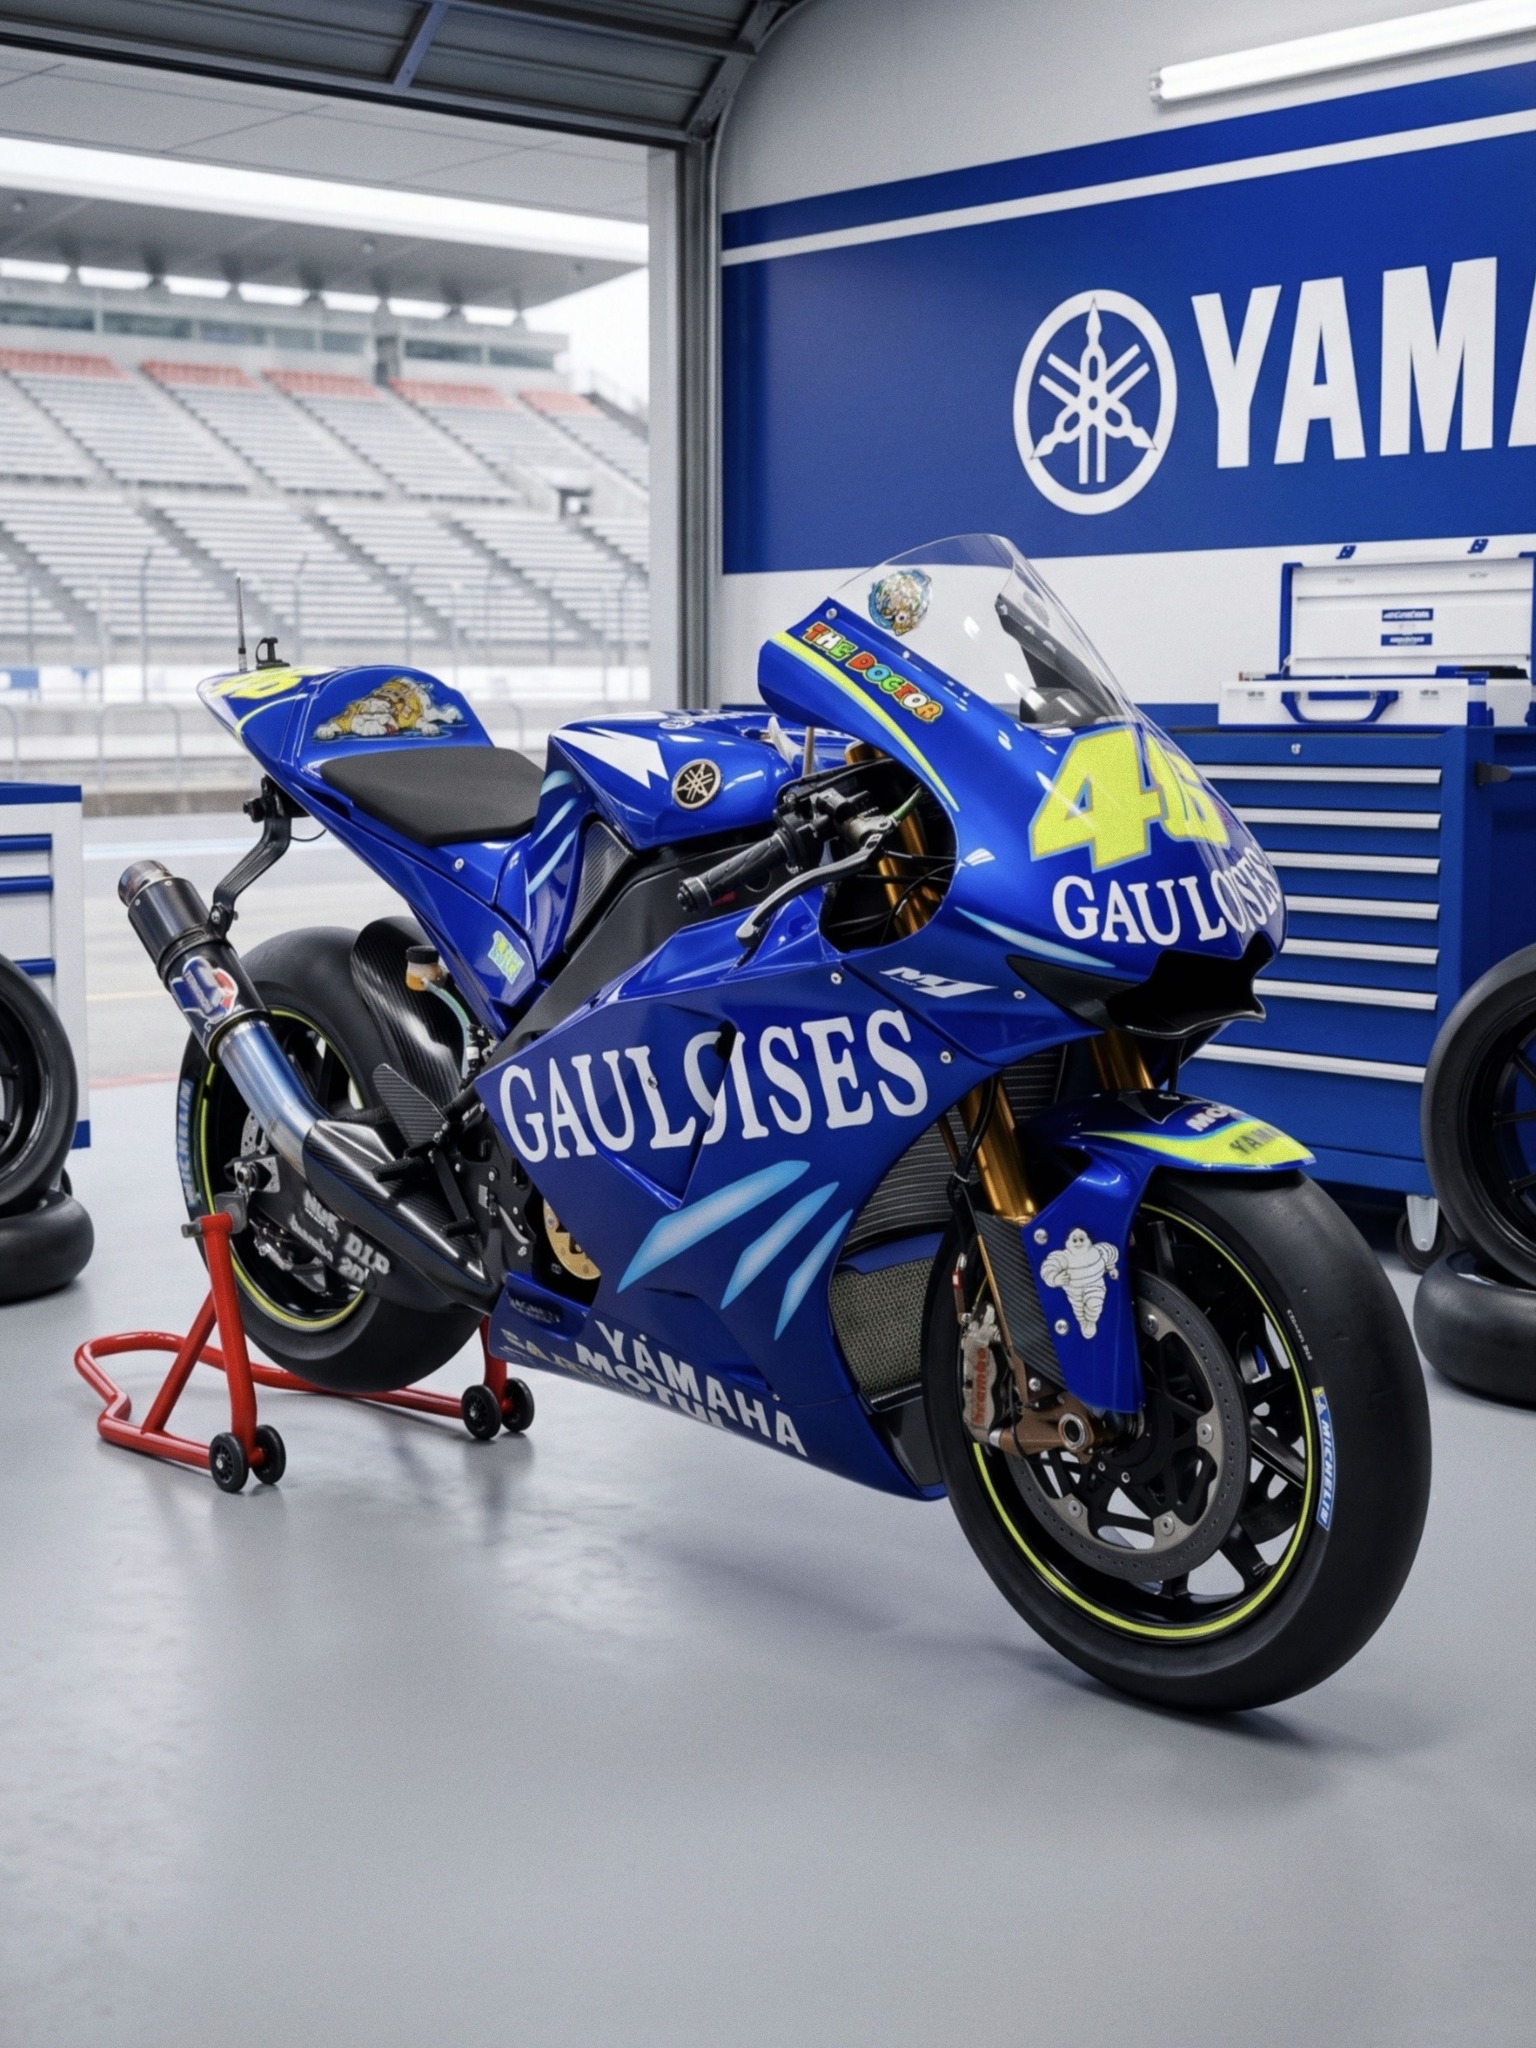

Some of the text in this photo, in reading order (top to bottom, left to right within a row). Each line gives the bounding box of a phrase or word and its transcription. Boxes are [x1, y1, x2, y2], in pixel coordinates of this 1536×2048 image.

[802, 621, 943, 723] THE DOCTOR
[1028, 724, 1231, 874] 46
[500, 1009, 928, 1163] GAULOISES
[595, 1319, 808, 1457] YAMAHA
